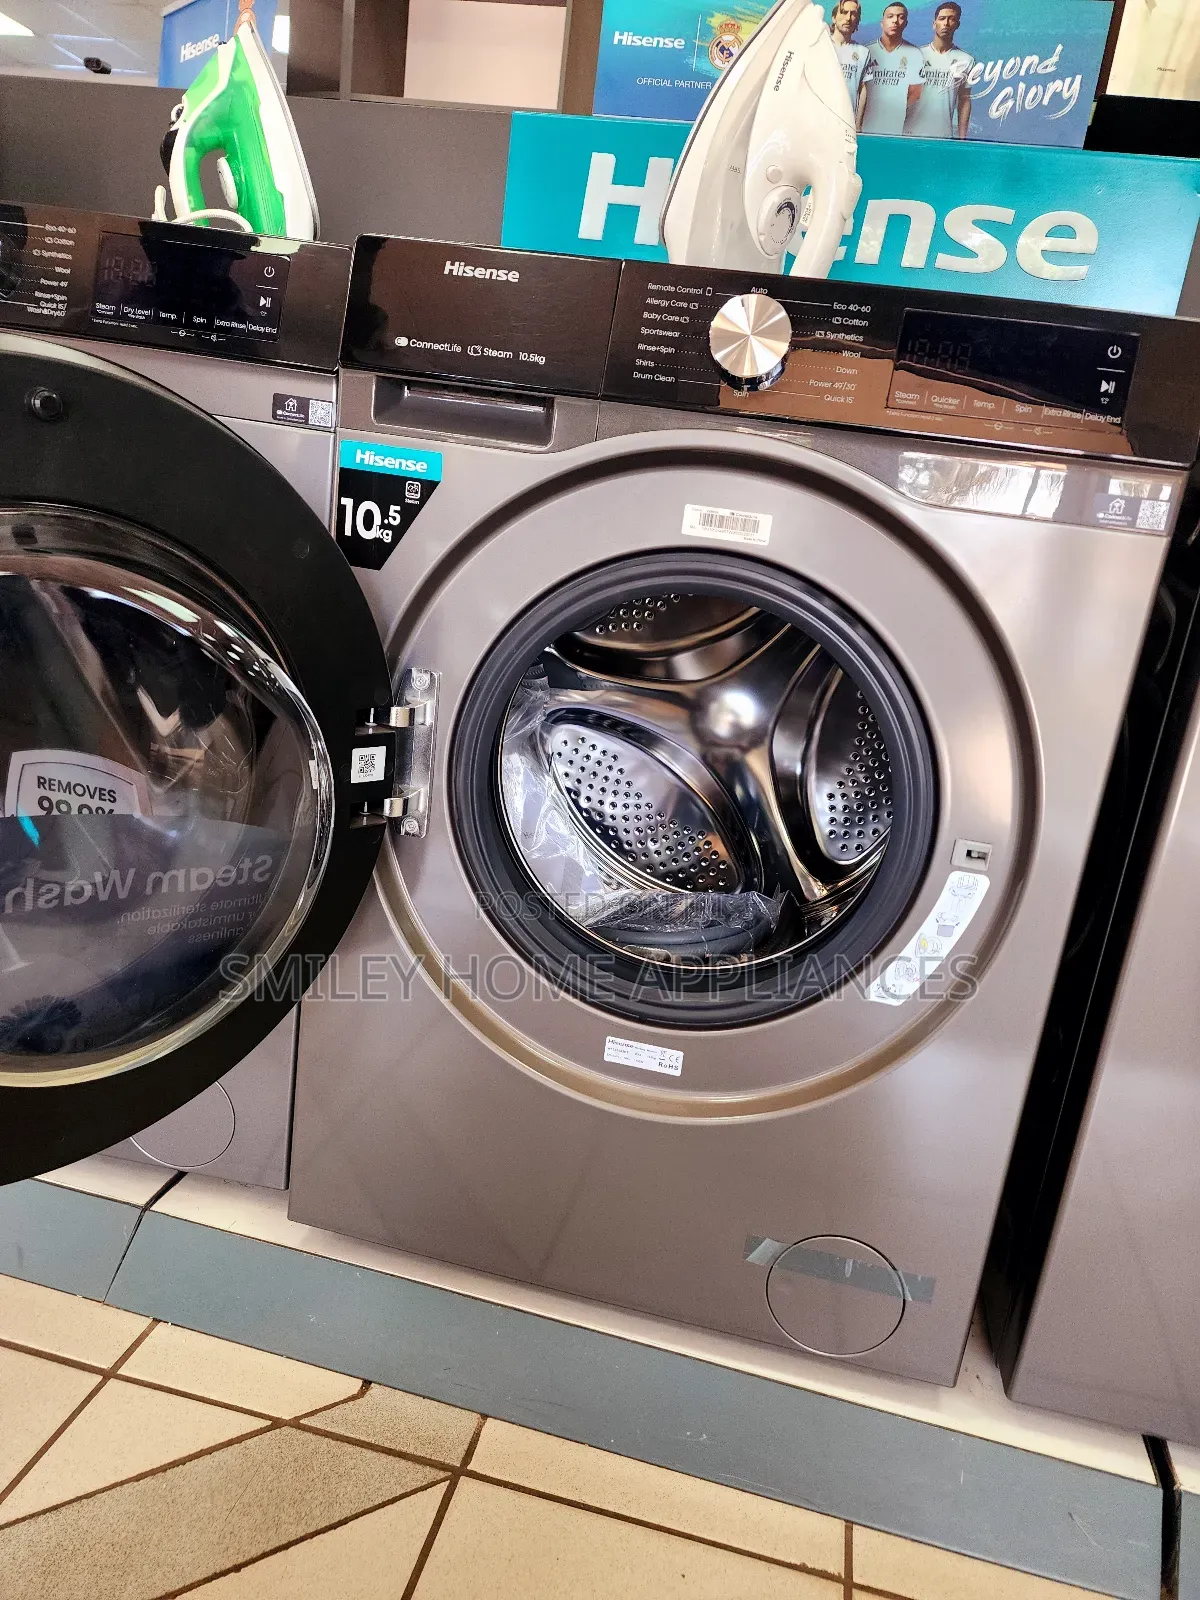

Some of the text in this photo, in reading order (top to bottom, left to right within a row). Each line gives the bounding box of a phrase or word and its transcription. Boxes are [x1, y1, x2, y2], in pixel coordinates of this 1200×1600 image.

[613, 31, 685, 49] Hisense
[180, 33, 219, 63] Hisense
[773, 50, 794, 92] Hisense
[946, 44, 1063, 99] Beyond
[636, 77, 712, 90] OFFICIAL PARTNER
[988, 74, 1082, 125] Glory
[577, 151, 1100, 281] Hnse
[54, 237, 75, 246] Cotton
[42, 250, 73, 260] Synthetics
[55, 266, 71, 274] Wool
[443, 260, 520, 283] Hisense
[40, 277, 59, 287] Power
[647, 282, 703, 295] Remote Control
[750, 286, 768, 294] Auto
[40, 300, 57, 309] Quick
[95, 302, 116, 311] Steam
[645, 297, 688, 308] Allergy Care
[833, 302, 871, 313] Eco 40-60
[123, 306, 151, 316] Dry Level
[159, 311, 177, 320] Temp.
[643, 311, 680, 322] Baby Care
[192, 316, 206, 324] Spin
[216, 319, 246, 329] Extra Rinse
[842, 317, 869, 327] Cotton
[249, 324, 265, 333] Delay
[640, 327, 681, 338] Sportswear
[826, 331, 863, 342] Synthetics
[410, 338, 462, 353] ConnectLife
[637, 343, 675, 354] Rinse+Spin
[484, 347, 546, 365] Steam 10.5kg
[842, 350, 861, 358] Wool
[635, 359, 655, 367] Shirts
[836, 366, 858, 375] Down
[633, 371, 676, 382] Drum Clean
[809, 379, 832, 389] Power
[733, 389, 749, 398] Spin
[824, 394, 845, 403] Quick
[894, 390, 920, 400] Steam
[931, 395, 961, 405] Quicker
[973, 399, 996, 410] Temp.
[1015, 405, 1032, 414] Spin
[1044, 408, 1081, 420] Extra Rinse
[1085, 412, 1121, 424] Delay End
[355, 448, 428, 473] Hisense
[376, 525, 393, 543] kg
[37, 775, 117, 804] REMOVES
[658, 1061, 679, 1071] RoHS
